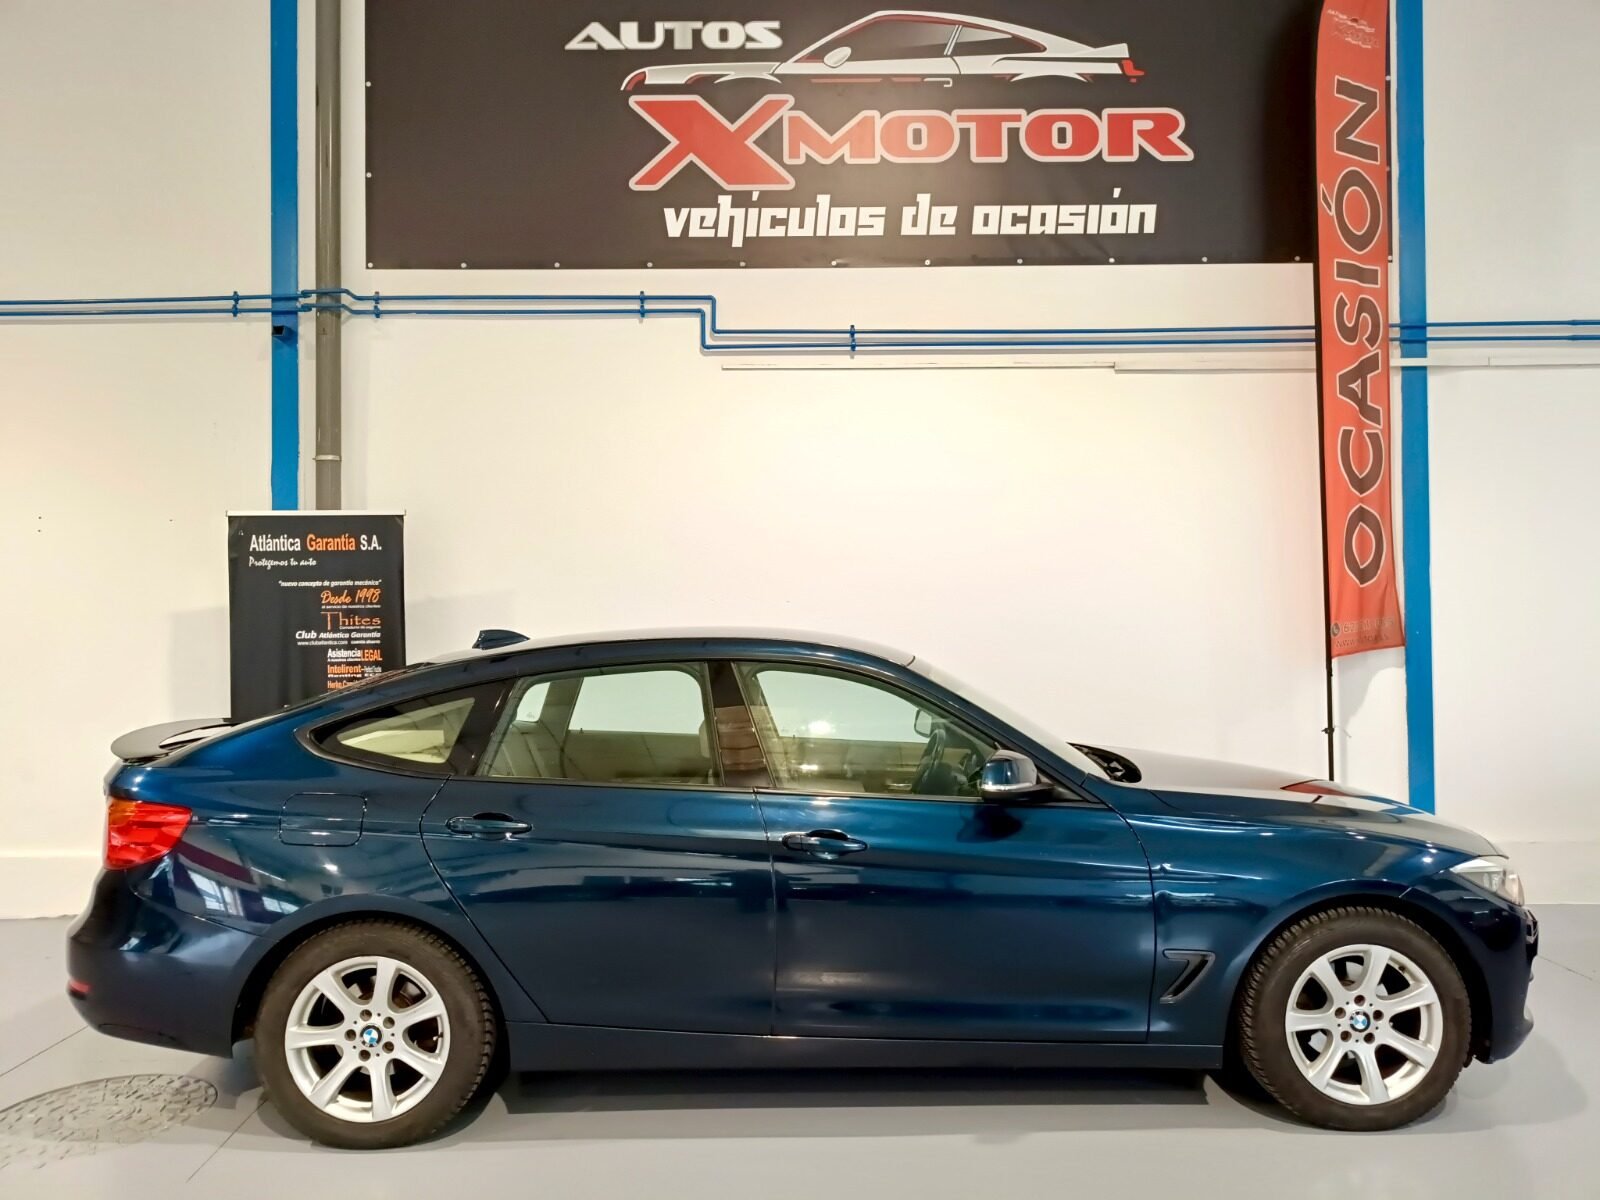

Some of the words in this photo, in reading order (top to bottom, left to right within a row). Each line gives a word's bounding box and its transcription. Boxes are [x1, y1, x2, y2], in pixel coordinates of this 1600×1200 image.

[564, 20, 783, 51] AUTOS
[901, 193, 957, 237] de
[971, 187, 1158, 236] ocasión
[1320, 74, 1386, 588] OCASIÓN
[249, 534, 301, 551] Atlántica
[306, 533, 356, 551] Garantía
[360, 534, 382, 551] S.A.
[320, 588, 352, 605] Desde
[355, 587, 382, 604] 1998
[295, 630, 317, 639] Club
